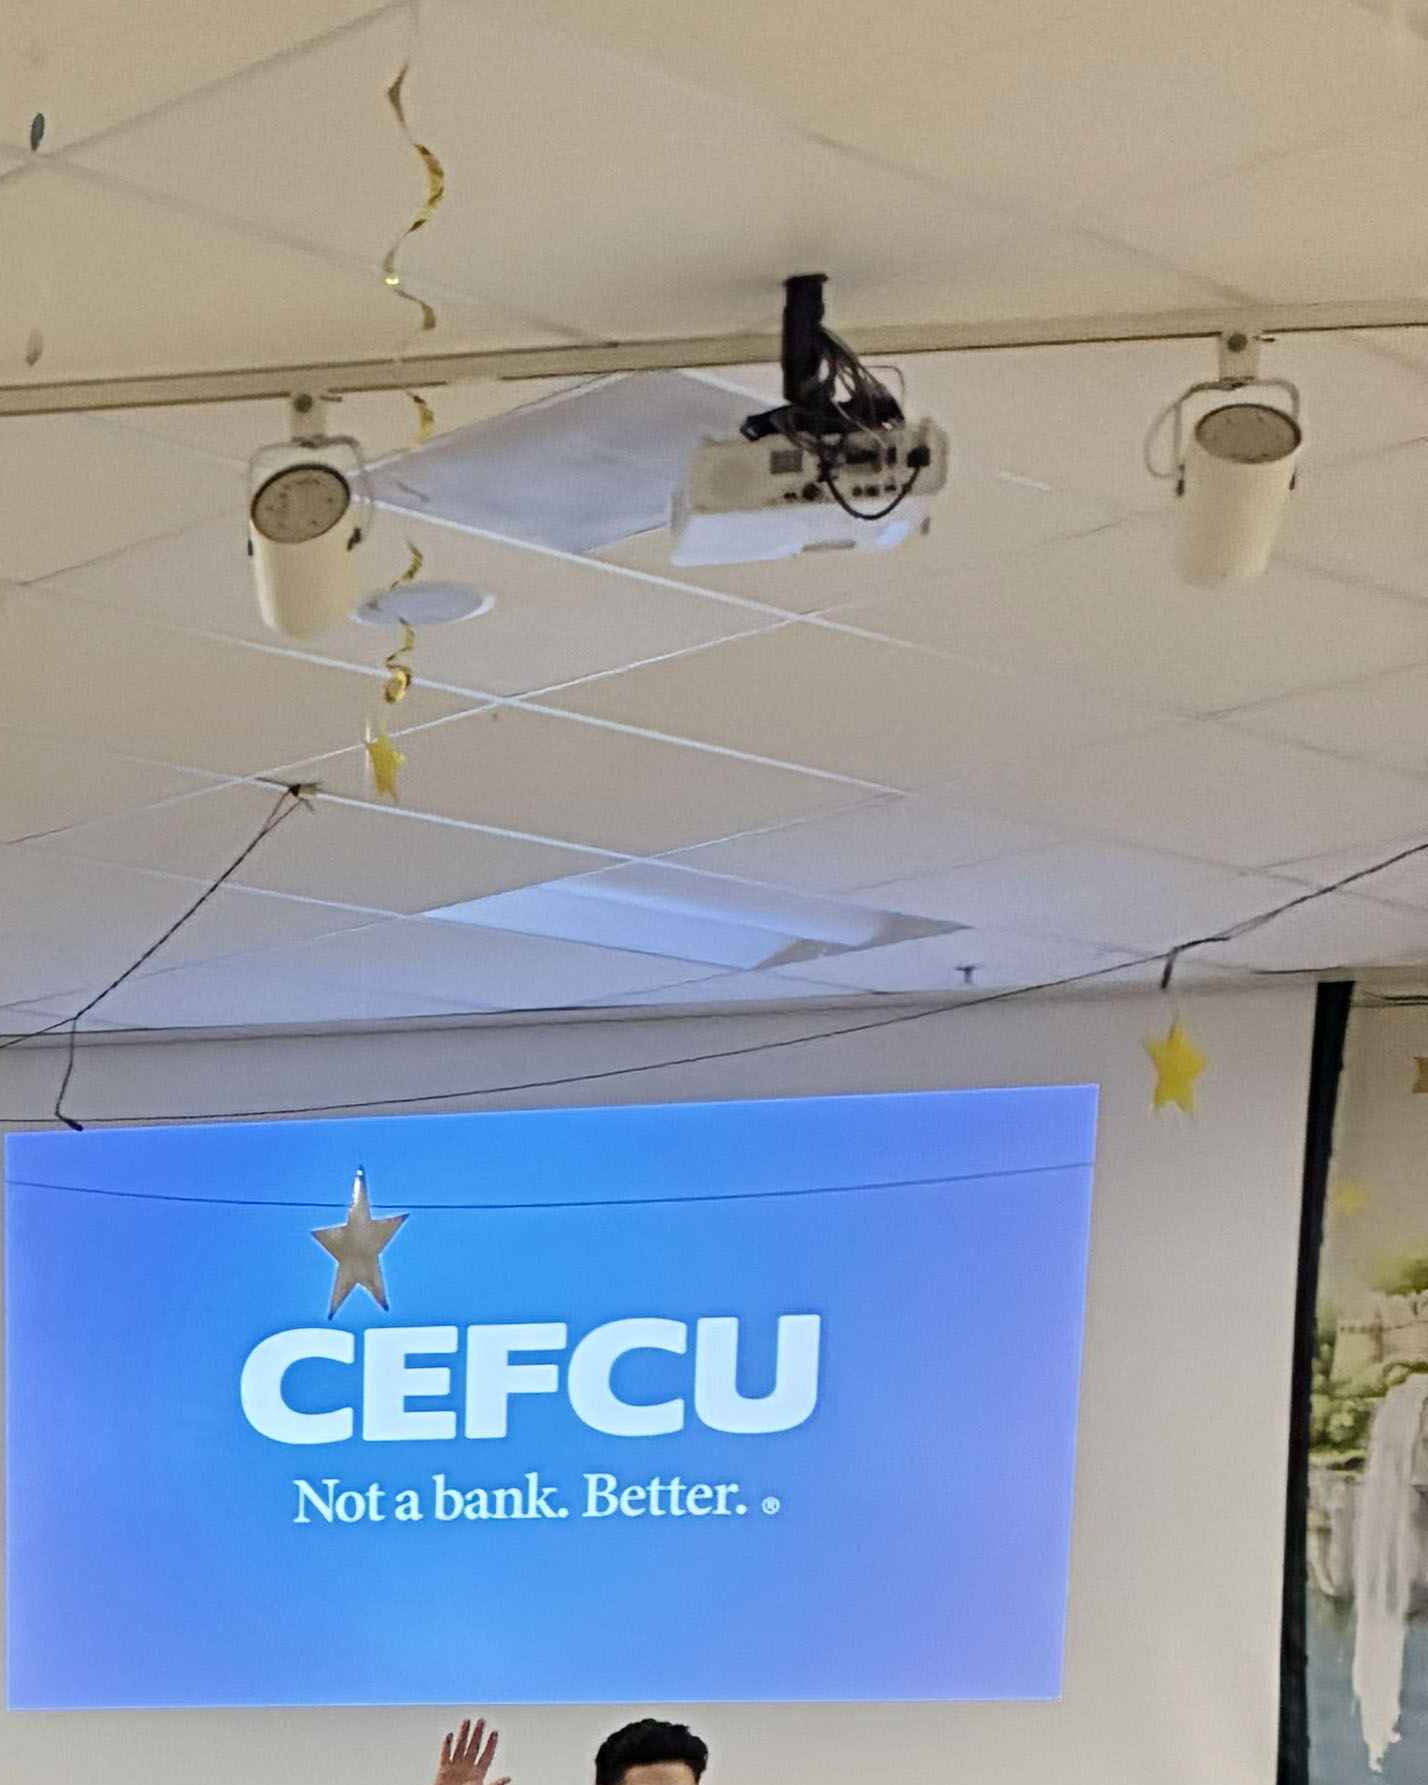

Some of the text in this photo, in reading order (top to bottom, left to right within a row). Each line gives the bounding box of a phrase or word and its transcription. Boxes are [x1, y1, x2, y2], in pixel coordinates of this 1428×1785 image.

[240, 1314, 822, 1445] CEFCU
[293, 1478, 385, 1523] Not
[394, 1490, 423, 1522] a
[432, 1472, 570, 1521] bank.
[582, 1473, 748, 1517] Better.
